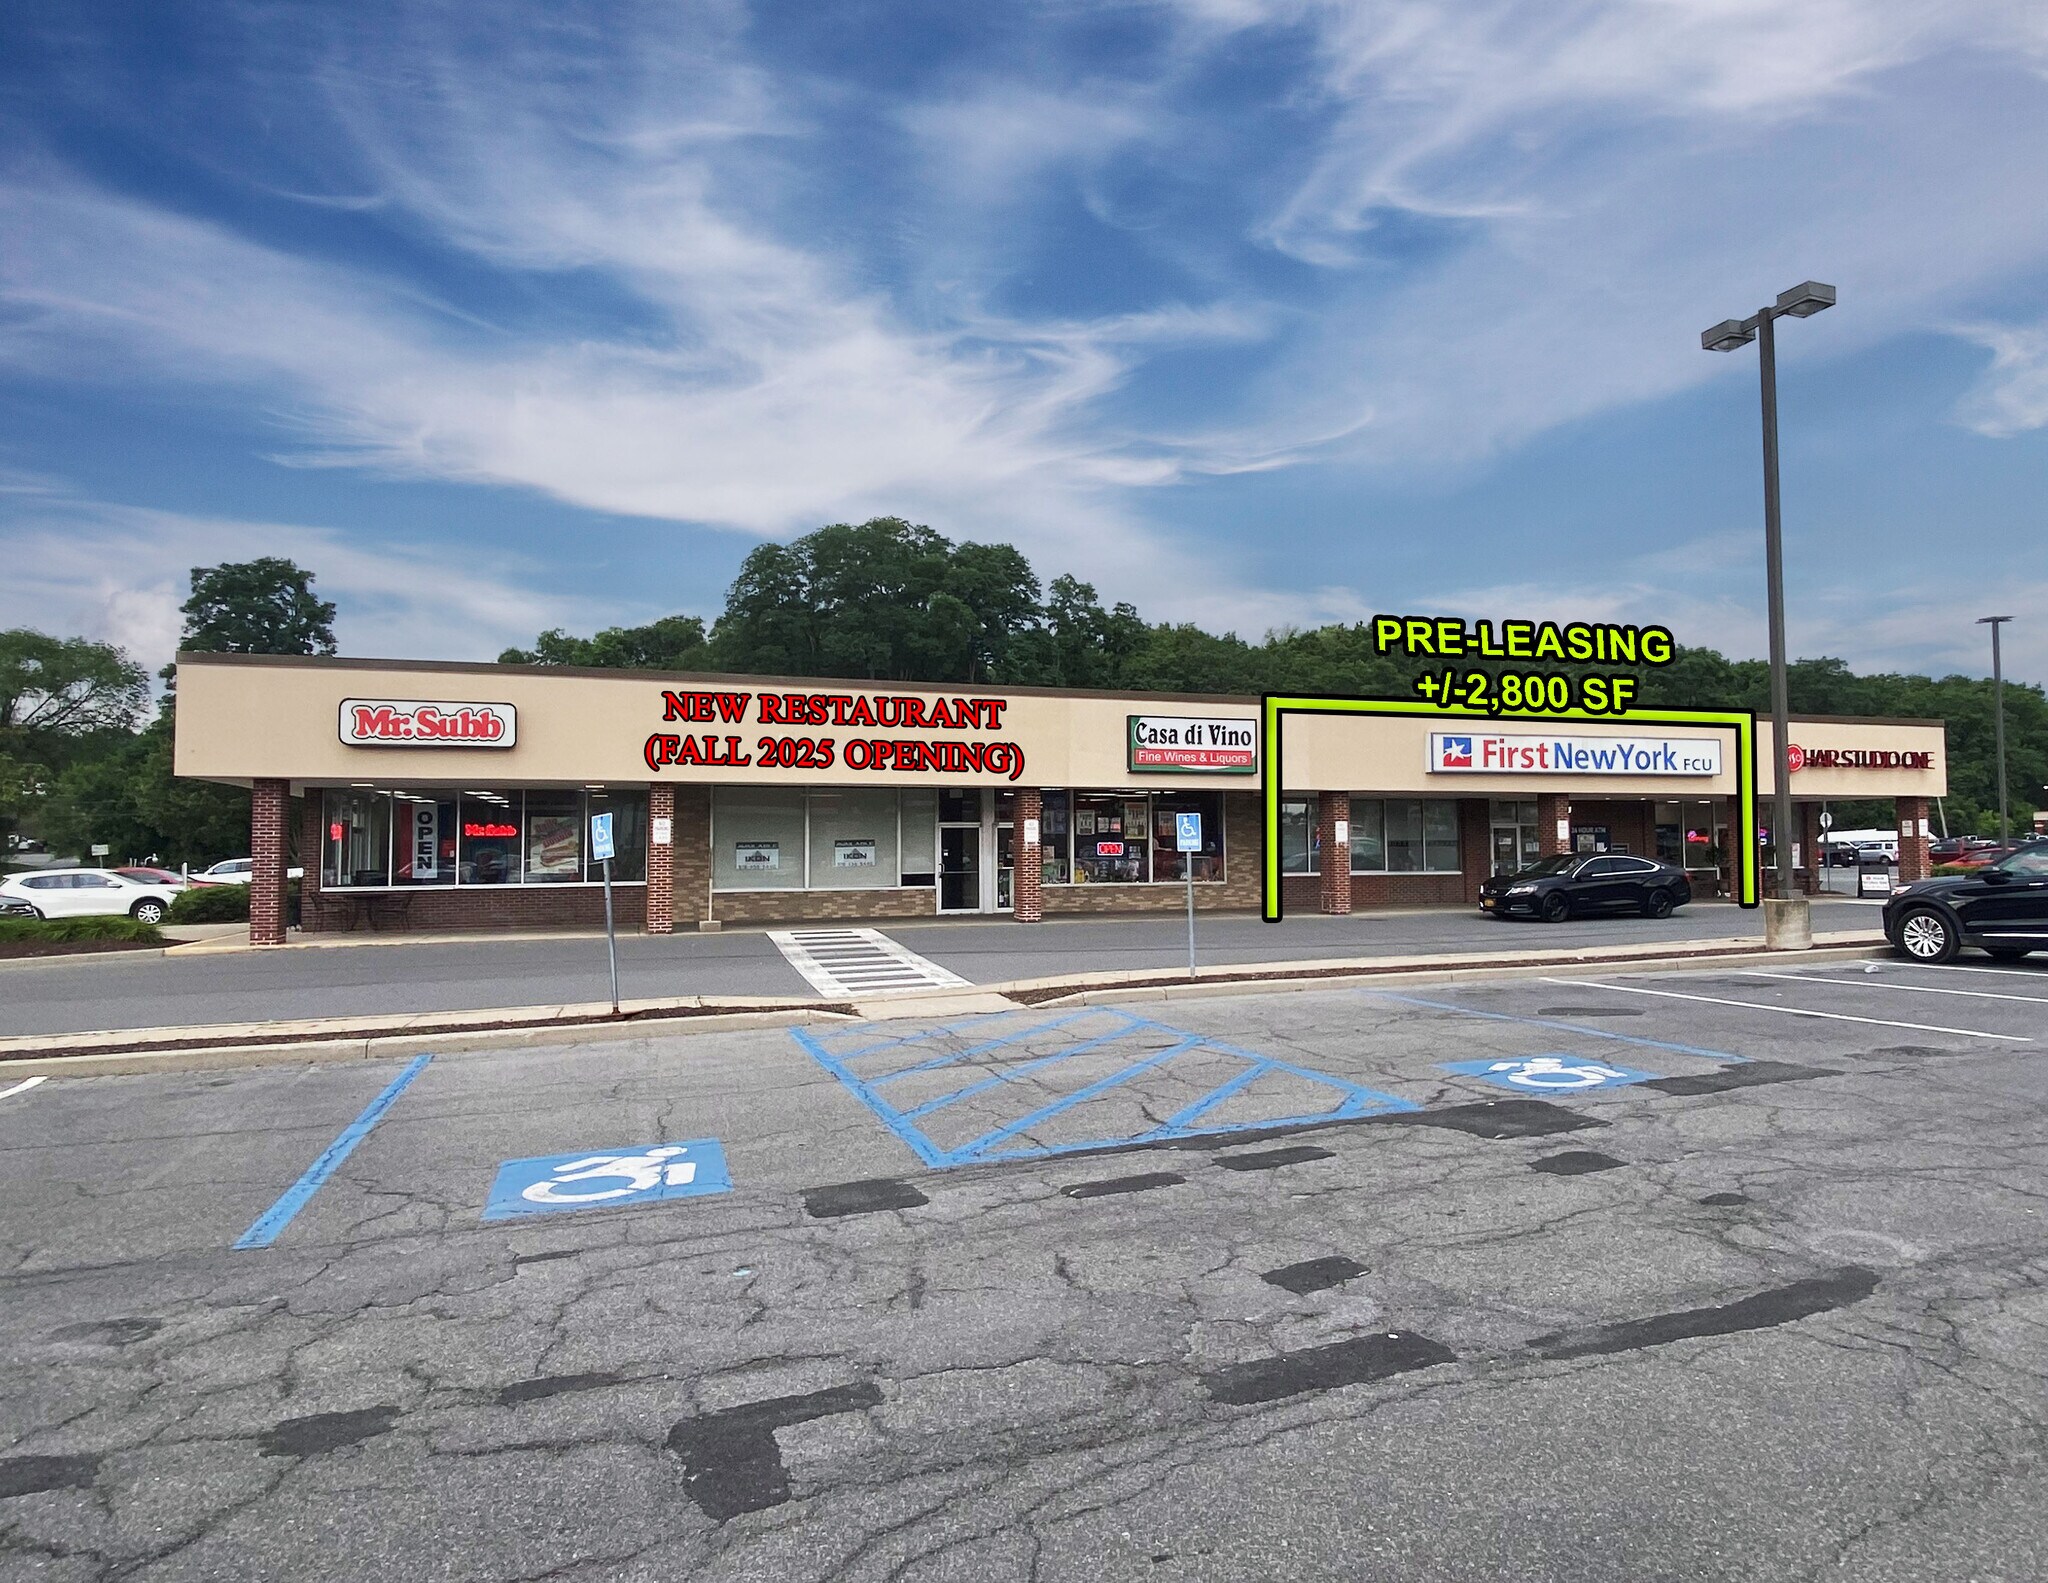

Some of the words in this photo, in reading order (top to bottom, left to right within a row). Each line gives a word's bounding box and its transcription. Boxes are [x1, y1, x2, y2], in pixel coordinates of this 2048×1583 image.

[355, 708, 412, 737] Mr.
[416, 710, 501, 739] Subb
[1135, 722, 1179, 745] Casa
[1184, 723, 1203, 746] di
[1208, 724, 1252, 746] Vino
[1138, 751, 1162, 762] Fine
[1164, 752, 1197, 763] Wines
[1198, 752, 1208, 763] &
[1209, 753, 1248, 765] Liquors
[1684, 758, 1713, 771] FCU
[1901, 751, 1936, 770] ONE
[416, 810, 434, 870] OPEN
[1099, 843, 1122, 855] OPEN
